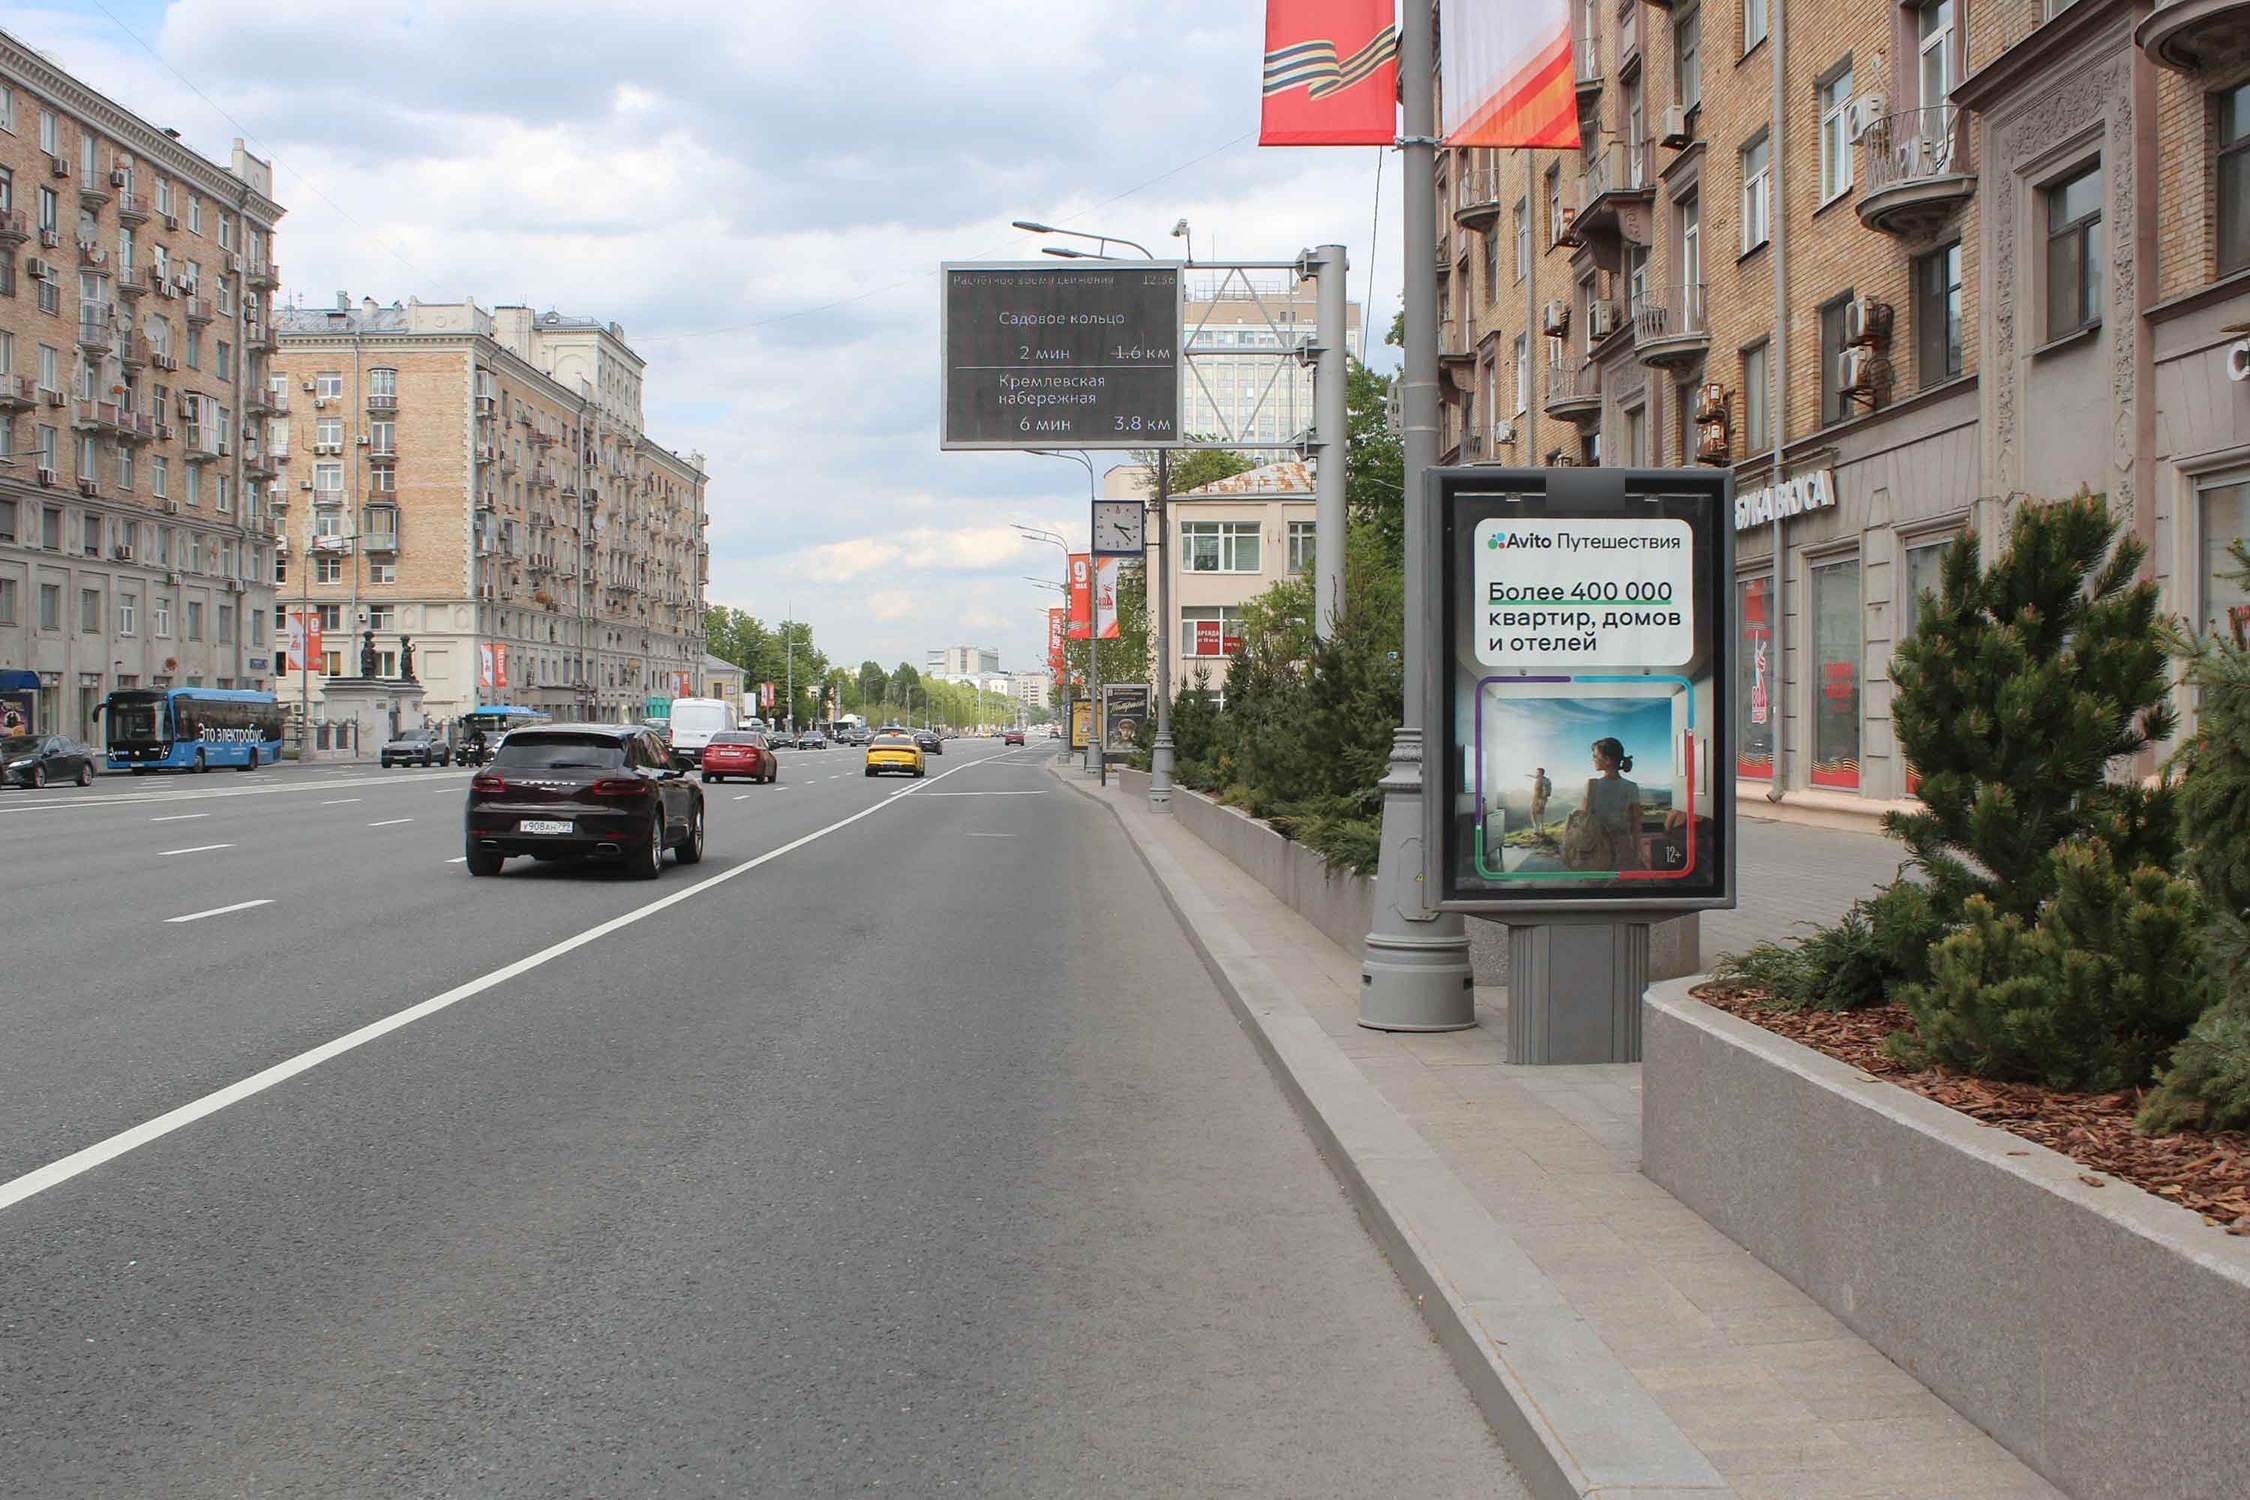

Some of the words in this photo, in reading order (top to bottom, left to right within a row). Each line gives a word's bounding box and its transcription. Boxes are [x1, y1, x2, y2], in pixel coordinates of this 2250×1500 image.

[999, 312, 1065, 326] Садовое
[1070, 314, 1125, 326] кольцо
[1019, 346, 1030, 360] 2
[1036, 348, 1070, 360] мин
[1114, 346, 1141, 360] 1.6
[1146, 348, 1170, 359] км
[999, 374, 1105, 391] Кремлевская
[999, 391, 1096, 408] набережная
[1019, 418, 1030, 431] 6
[1036, 419, 1071, 431] мин
[1114, 416, 1142, 431] 3.8
[1147, 419, 1171, 430] км
[1506, 532, 1552, 549] Avito
[1557, 533, 1680, 553] Путешествия
[1074, 561, 1087, 582] 9
[1489, 582, 1564, 600] Более
[1571, 582, 1618, 600] 400
[1625, 582, 1672, 600] 000
[1489, 611, 1596, 630] квартир,
[1603, 611, 1681, 629] домов
[1489, 637, 1502, 651] и
[1510, 631, 1597, 651] отелей
[198, 722, 216, 743] Это
[217, 723, 267, 747] электробус.
[1665, 845, 1682, 863] 12+
